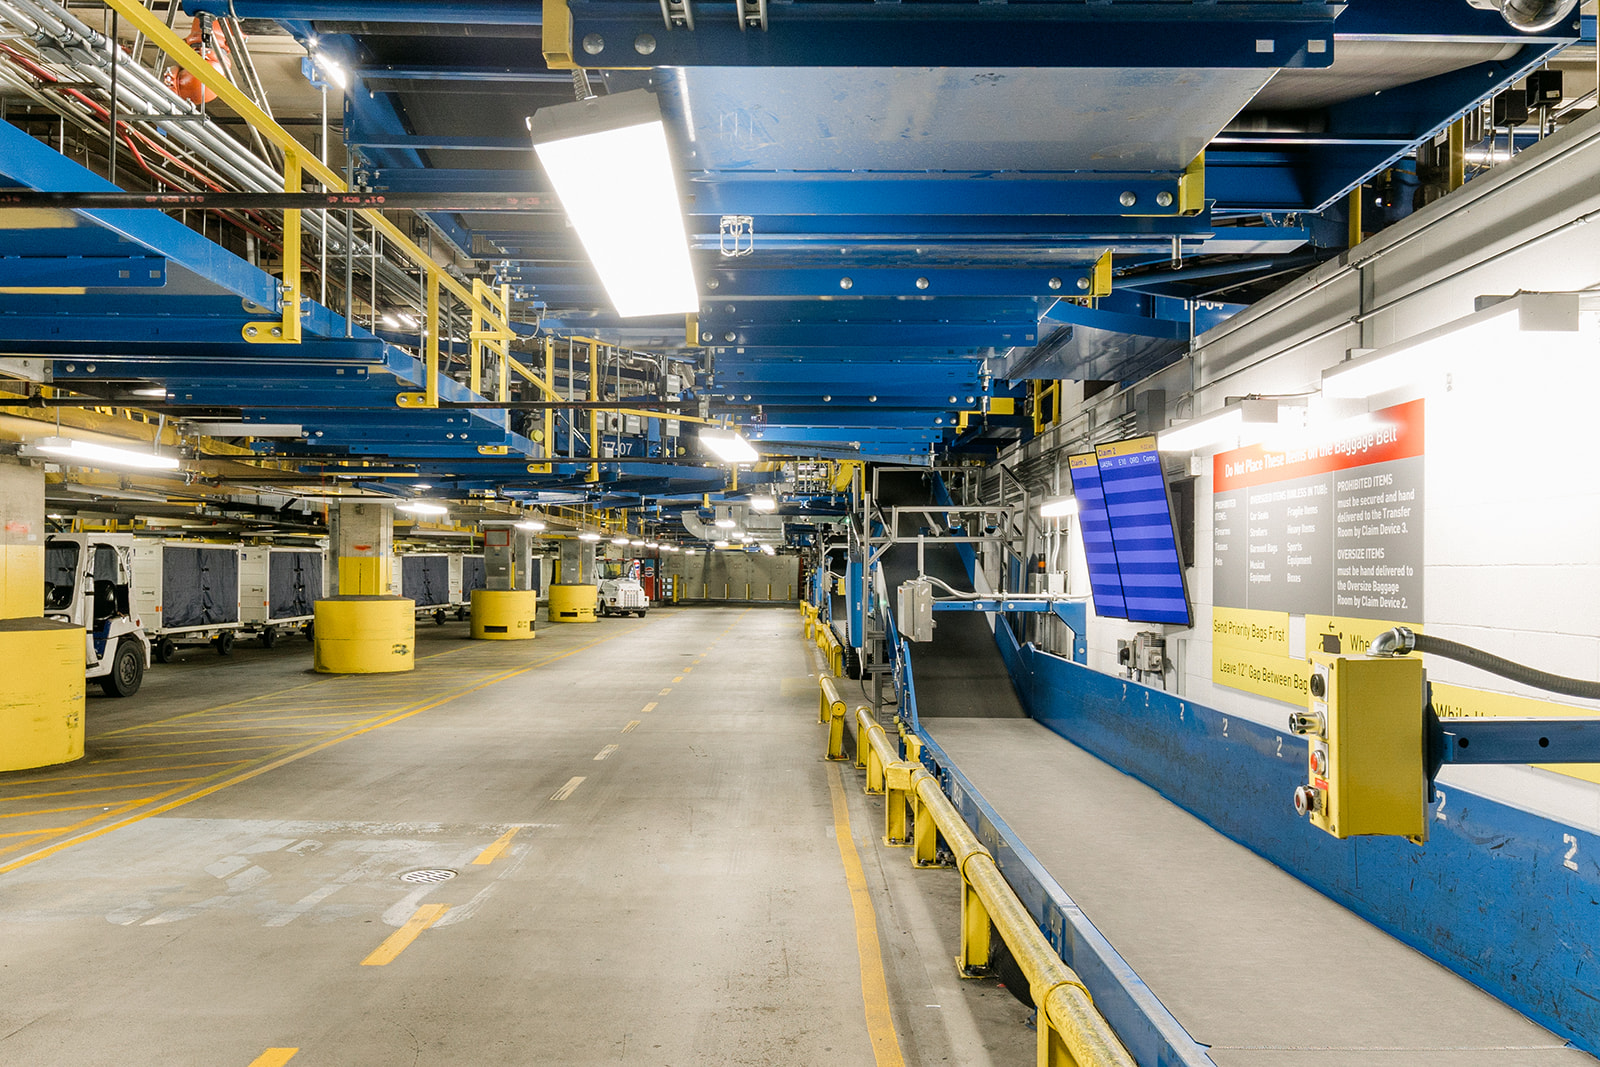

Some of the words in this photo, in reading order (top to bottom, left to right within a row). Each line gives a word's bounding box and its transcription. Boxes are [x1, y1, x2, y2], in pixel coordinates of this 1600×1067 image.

[1098, 448, 1112, 457] Claim
[1112, 447, 1116, 455] 2
[1224, 463, 1234, 478] Do
[1234, 460, 1244, 476] Not
[1245, 458, 1264, 473] Place
[1264, 454, 1285, 470] These
[1308, 445, 1318, 460] on
[1334, 433, 1374, 456] Baggage
[1376, 427, 1398, 446] Belt
[1071, 459, 1083, 467] Claim
[1084, 458, 1088, 466] 2
[1337, 476, 1372, 492] PROHIBITED
[1372, 474, 1392, 487] ITEMS
[1337, 497, 1351, 508] must
[1352, 496, 1359, 507] be
[1360, 492, 1384, 506] secured
[1385, 490, 1397, 503] and
[1398, 488, 1415, 501] hand
[1287, 506, 1304, 518] Fragile
[1304, 505, 1318, 515] Items
[1337, 509, 1364, 522] delivered
[1364, 510, 1370, 520] to
[1372, 508, 1382, 520] the
[1382, 506, 1411, 519] Transfer
[1287, 524, 1301, 536] Heavy
[1302, 524, 1316, 533] Items
[1337, 526, 1353, 538] Room
[1354, 526, 1361, 538] by
[1362, 524, 1379, 536] Claim
[1380, 523, 1400, 536] Device
[1401, 522, 1408, 534] 3.
[1287, 542, 1303, 554] Sports
[1337, 548, 1364, 560] OVERSIZE
[1366, 548, 1384, 559] ITEMS
[1287, 555, 1312, 567] Equipment
[1337, 566, 1351, 576] must
[1352, 566, 1359, 576] be
[1360, 565, 1374, 576] hand
[1376, 564, 1406, 576] delivered
[1406, 566, 1414, 576] to
[1337, 580, 1346, 590] the
[1347, 580, 1372, 592] Oversize
[1372, 580, 1399, 595] Baggage
[1337, 594, 1353, 606] Room
[1354, 595, 1361, 608] by
[1362, 595, 1378, 607] Claim
[1380, 596, 1400, 608] Device
[1401, 597, 1408, 609] 2.
[1214, 619, 1228, 634] Send
[1228, 620, 1250, 640] Priority
[1252, 624, 1268, 642] Bags
[1268, 626, 1285, 642] First
[1350, 634, 1370, 652] Whe
[1220, 658, 1236, 675] Leave
[1238, 662, 1248, 677] 12"
[1249, 665, 1261, 684] Gap
[1262, 667, 1292, 688] Between
[1294, 673, 1308, 694] Bag
[1436, 703, 1469, 717] Whil
[1222, 718, 1228, 738] 2
[1276, 736, 1282, 758] 2
[1436, 790, 1446, 820] 2
[1563, 833, 1578, 872] 2
